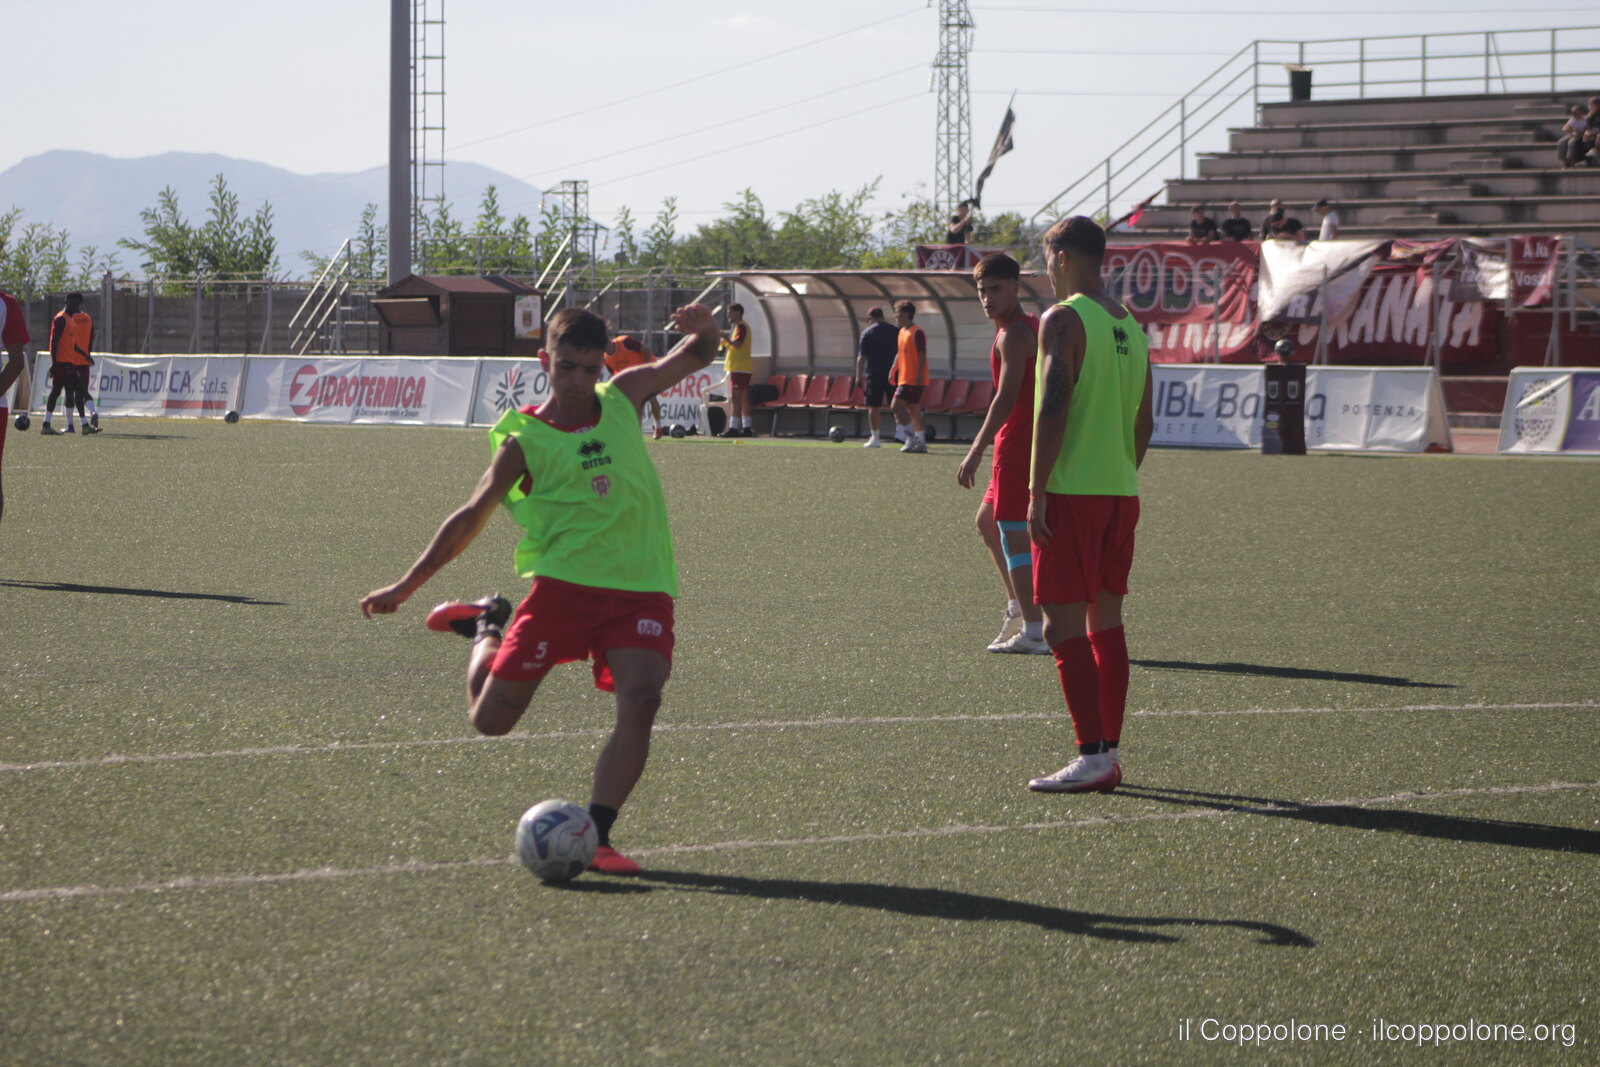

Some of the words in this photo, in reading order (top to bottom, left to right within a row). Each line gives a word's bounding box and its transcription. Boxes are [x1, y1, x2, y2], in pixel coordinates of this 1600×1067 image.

[1155, 381, 1205, 418] IBL
[1215, 383, 1327, 421] Baa
[1341, 404, 1415, 417] POTENZA
[535, 641, 548, 659] 5
